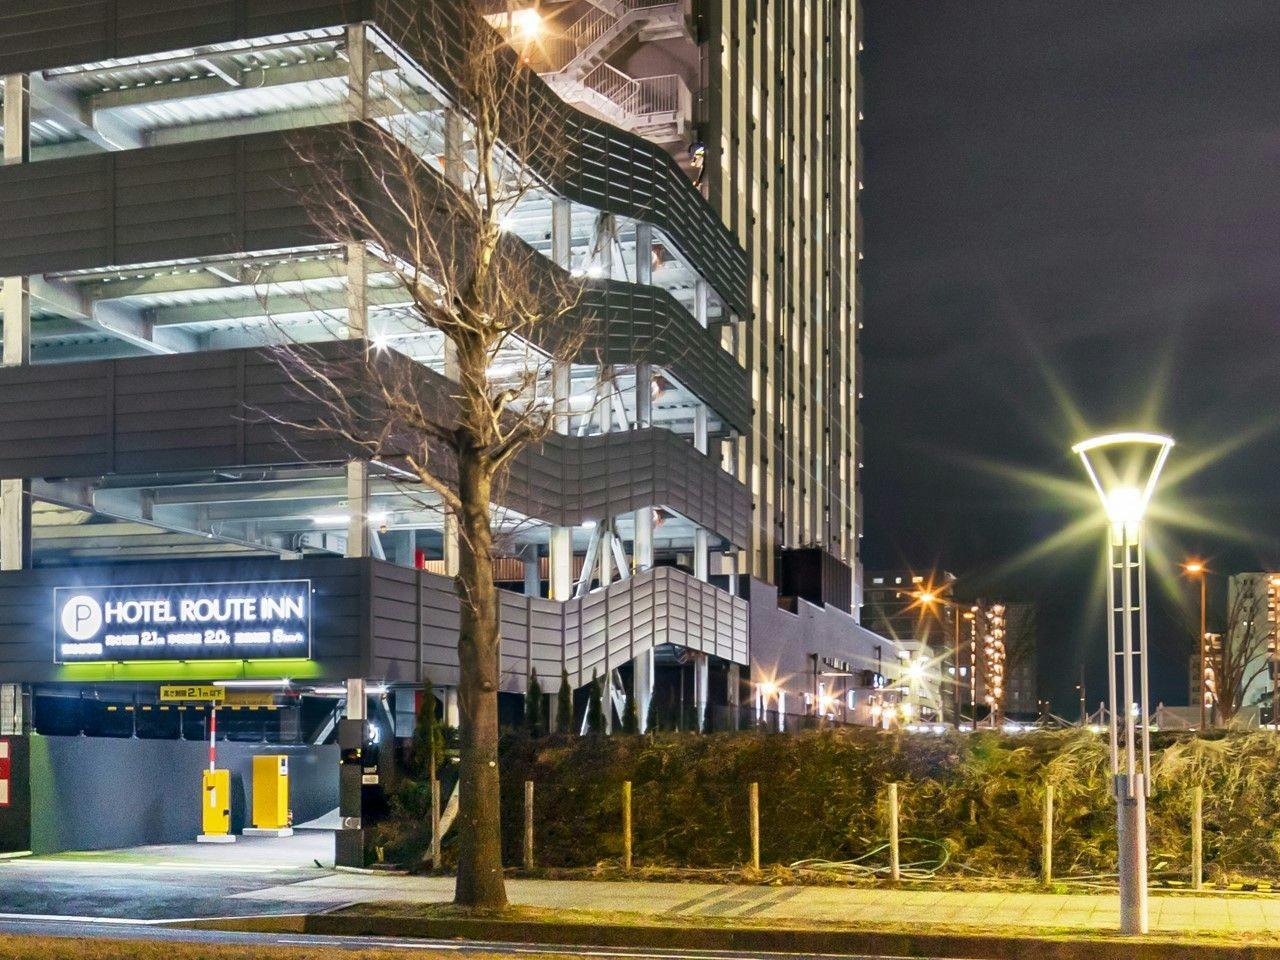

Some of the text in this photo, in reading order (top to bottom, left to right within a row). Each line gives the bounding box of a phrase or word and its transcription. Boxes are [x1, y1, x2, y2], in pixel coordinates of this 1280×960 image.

[105, 600, 177, 623] HOTEL
[180, 597, 256, 622] ROUTE
[261, 595, 304, 620] INN
